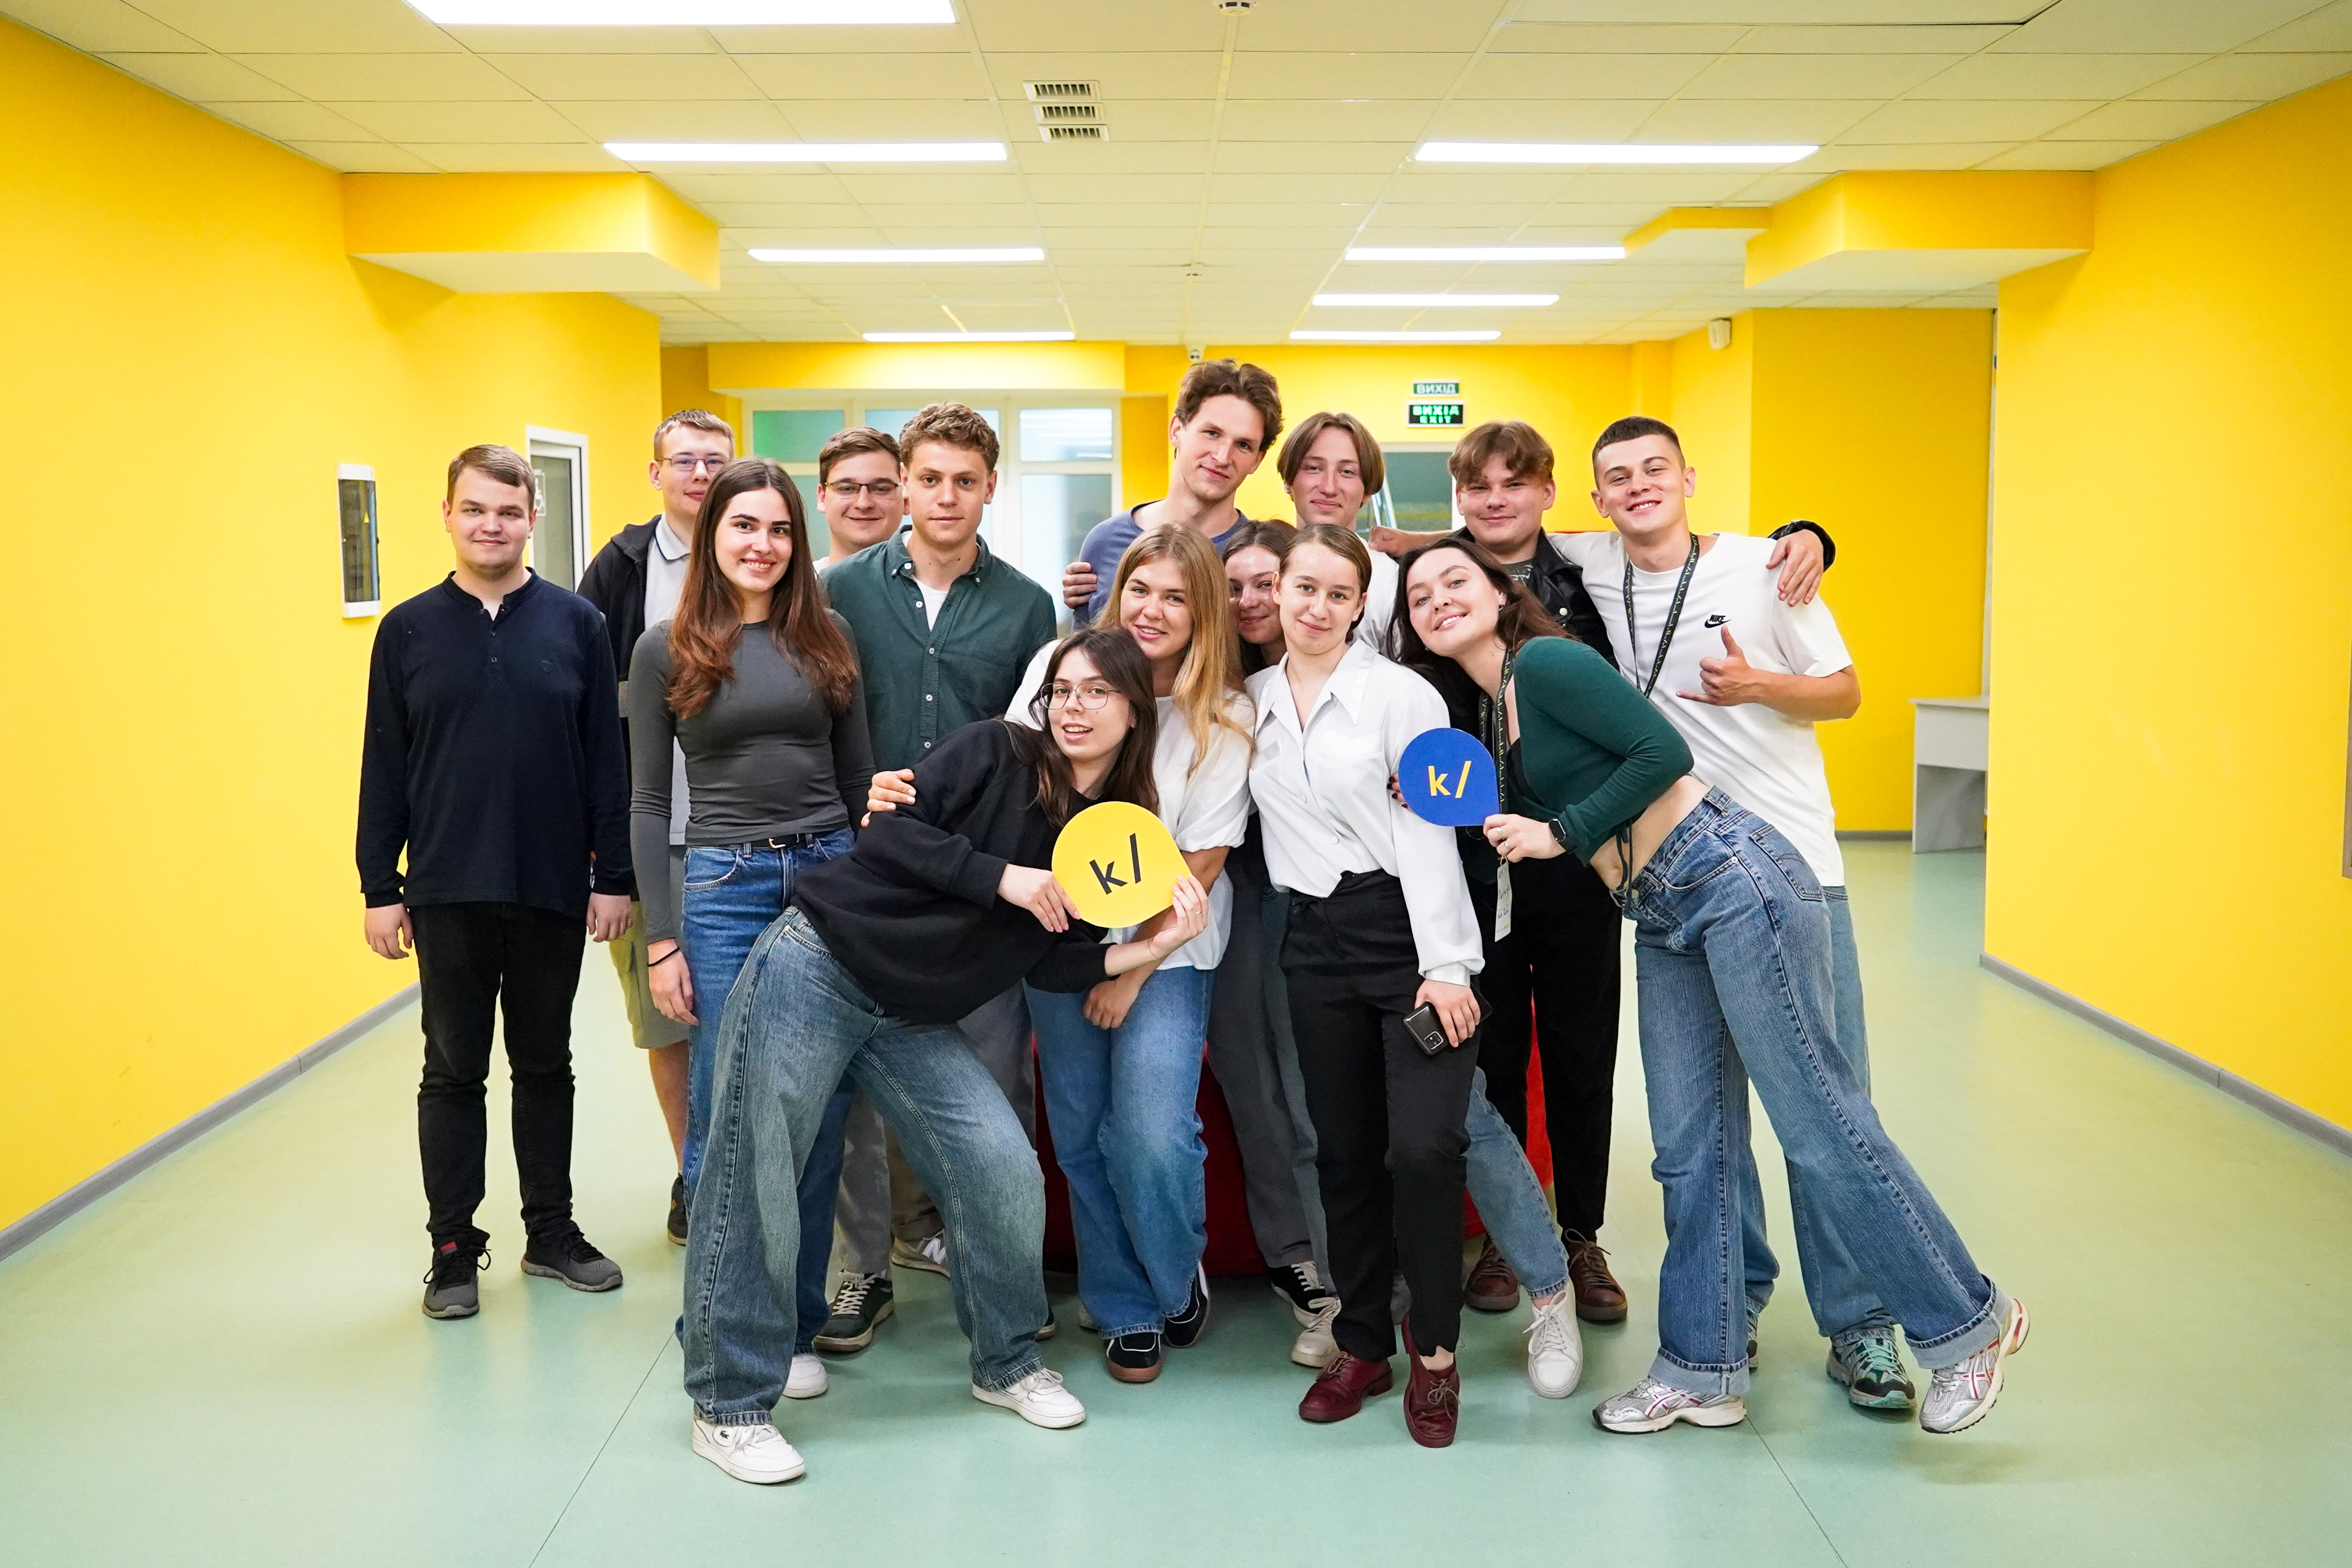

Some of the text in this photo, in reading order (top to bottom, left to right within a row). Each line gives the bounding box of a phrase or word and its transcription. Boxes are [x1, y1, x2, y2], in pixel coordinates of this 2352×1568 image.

[1416, 384, 1456, 394] ВИХІД
[1413, 405, 1460, 415] ВИХІД
[1419, 415, 1451, 424] EXIT
[1709, 614, 1726, 623] NIKE
